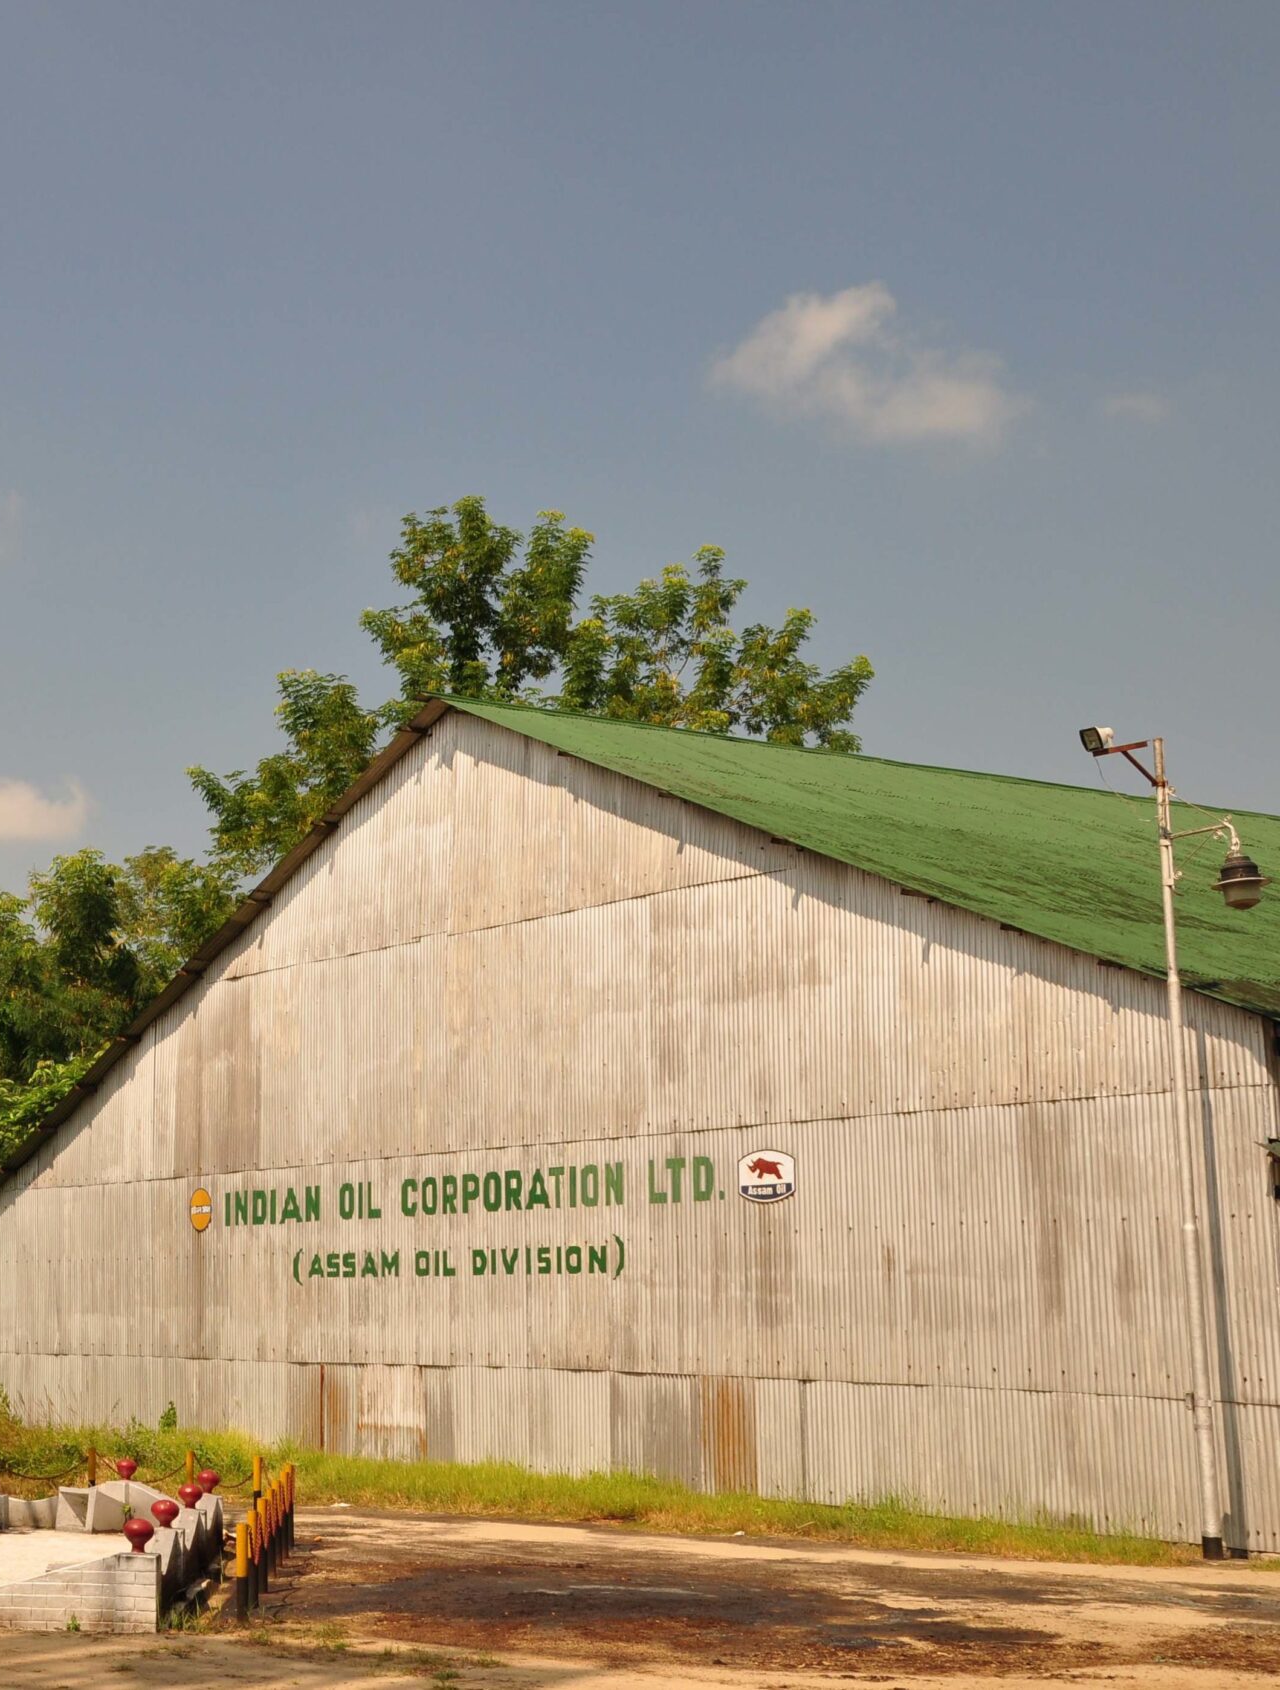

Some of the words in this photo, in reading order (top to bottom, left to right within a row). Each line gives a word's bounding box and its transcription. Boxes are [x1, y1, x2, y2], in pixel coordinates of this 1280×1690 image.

[224, 1185, 320, 1227] INDIAN
[338, 1181, 382, 1221] OIL
[401, 1161, 624, 1217] CORPORATION
[648, 1156, 725, 1205] LTD.
[747, 1185, 773, 1196] Assam
[775, 1183, 787, 1195] Oil
[292, 1248, 400, 1286] (ASSAM
[415, 1250, 456, 1277] OIL
[472, 1233, 625, 1280] DIVISION)
